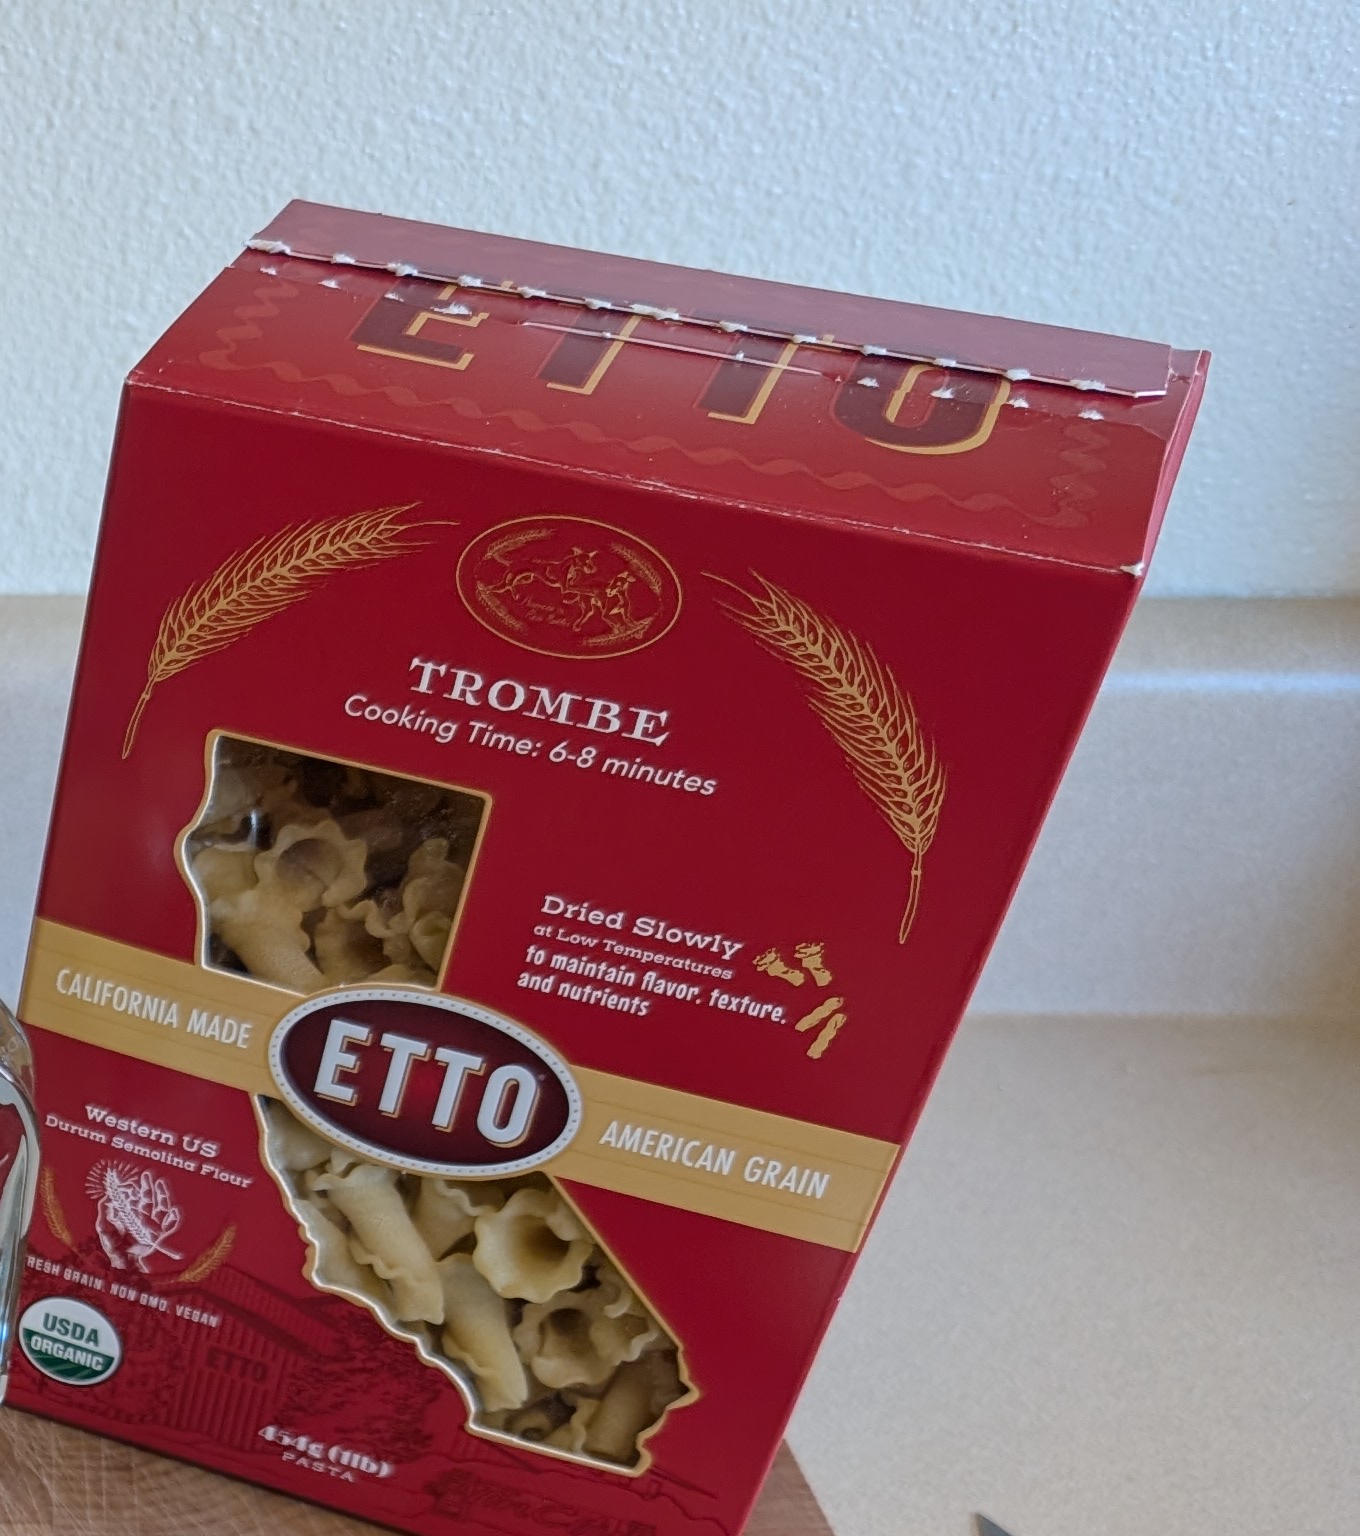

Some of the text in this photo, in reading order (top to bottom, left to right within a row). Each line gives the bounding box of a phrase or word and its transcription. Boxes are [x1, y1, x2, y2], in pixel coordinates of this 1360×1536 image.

[408, 656, 670, 747] TROMBE
[343, 694, 718, 796] Cooking Time: 6-8 minutes
[533, 924, 735, 980] at Low Temperatures
[540, 894, 744, 961] Dried Slowly
[517, 971, 650, 1017] and nutrients
[525, 945, 545, 965] to
[549, 950, 636, 987] maintain
[55, 968, 253, 1049] CALIFORNIA MADE
[314, 1018, 542, 1149] ETTO
[45, 1114, 254, 1189] Durum Semolina Flour
[85, 1104, 219, 1159] Western US
[599, 1120, 831, 1200] AMERICAN GRAIN
[25, 1255, 60, 1277] RESH
[110, 1283, 136, 1302] NON
[175, 1304, 221, 1328] VEGAN
[30, 1334, 104, 1371] ORGANIC
[42, 1312, 100, 1347] USDA
[282, 1452, 354, 1483] PASTA
